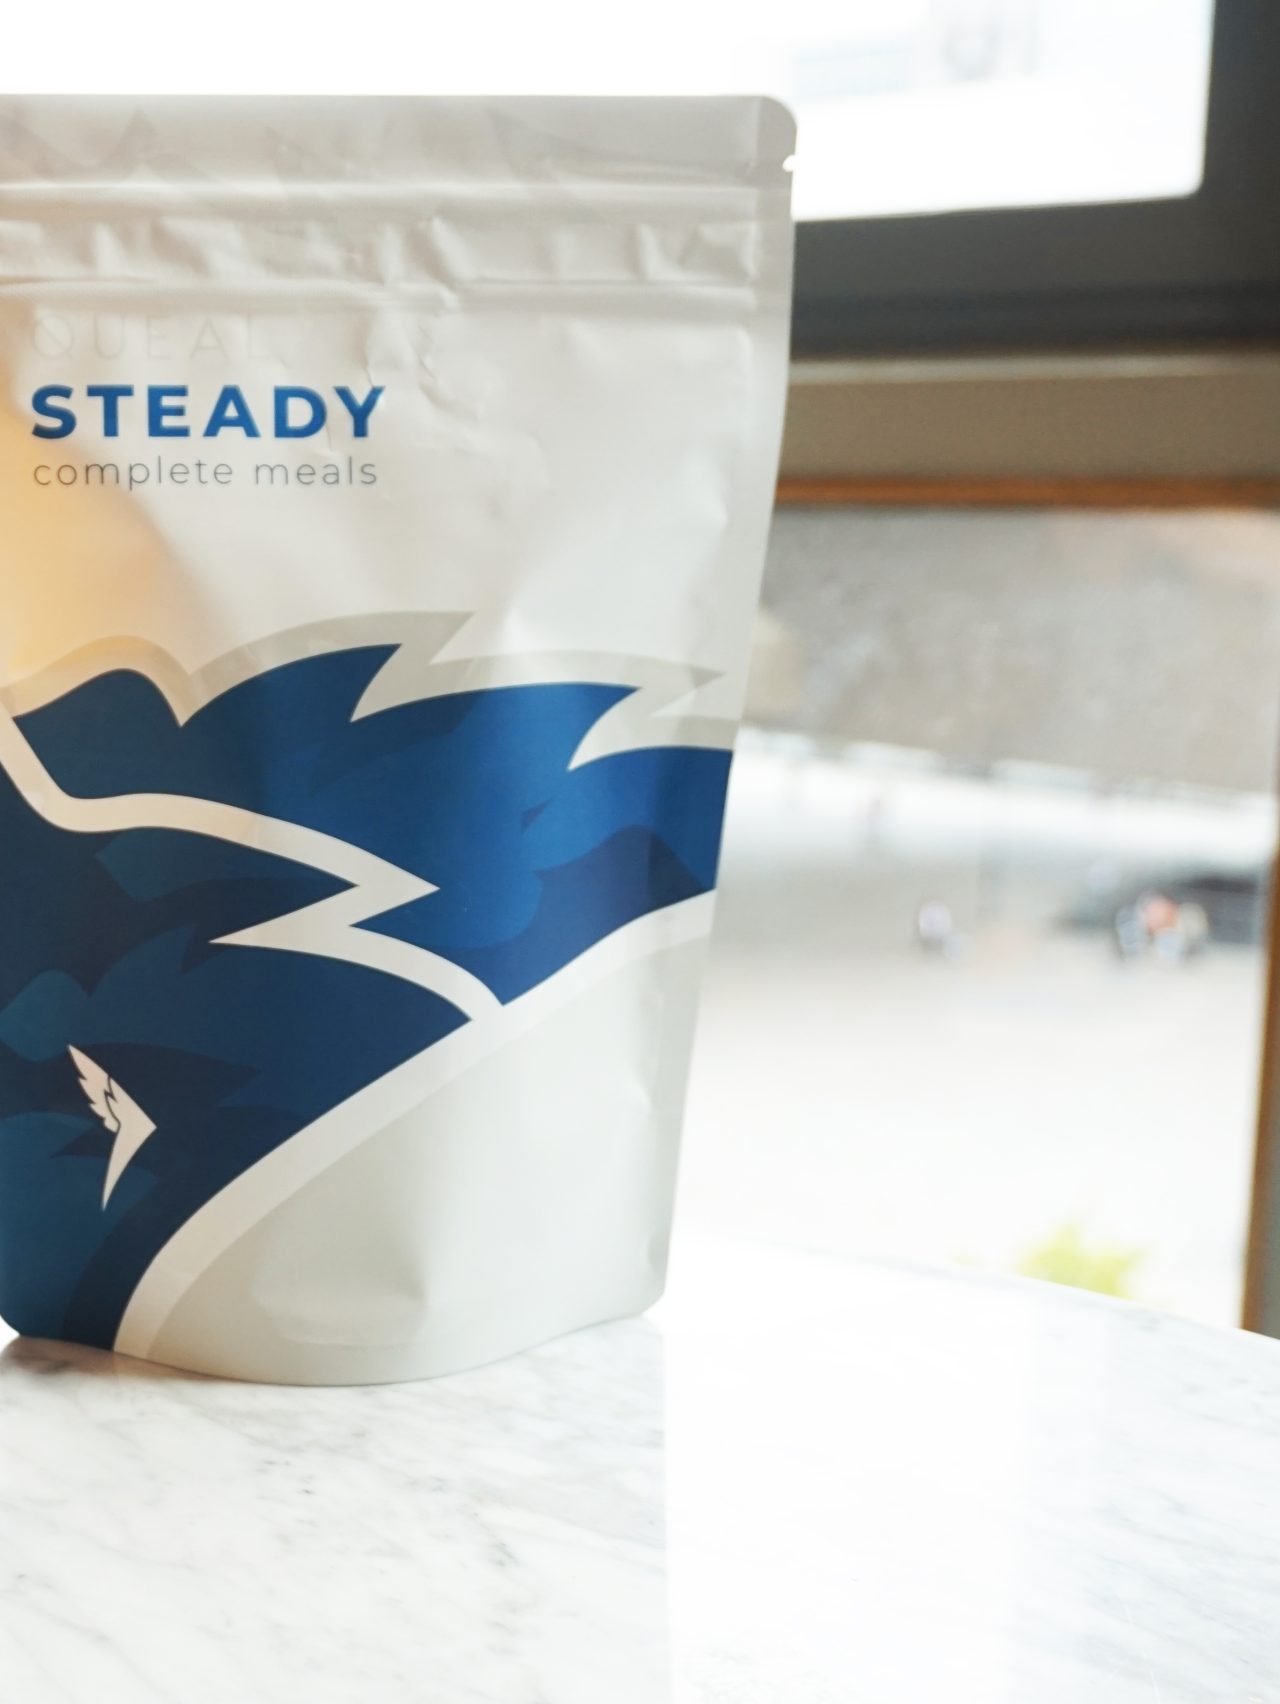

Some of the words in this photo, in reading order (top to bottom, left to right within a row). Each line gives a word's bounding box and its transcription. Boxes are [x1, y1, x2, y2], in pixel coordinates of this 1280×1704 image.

[32, 313, 273, 360] QUEAL
[31, 384, 386, 439] STEADY
[33, 455, 234, 491] complete
[255, 456, 378, 485] meals
